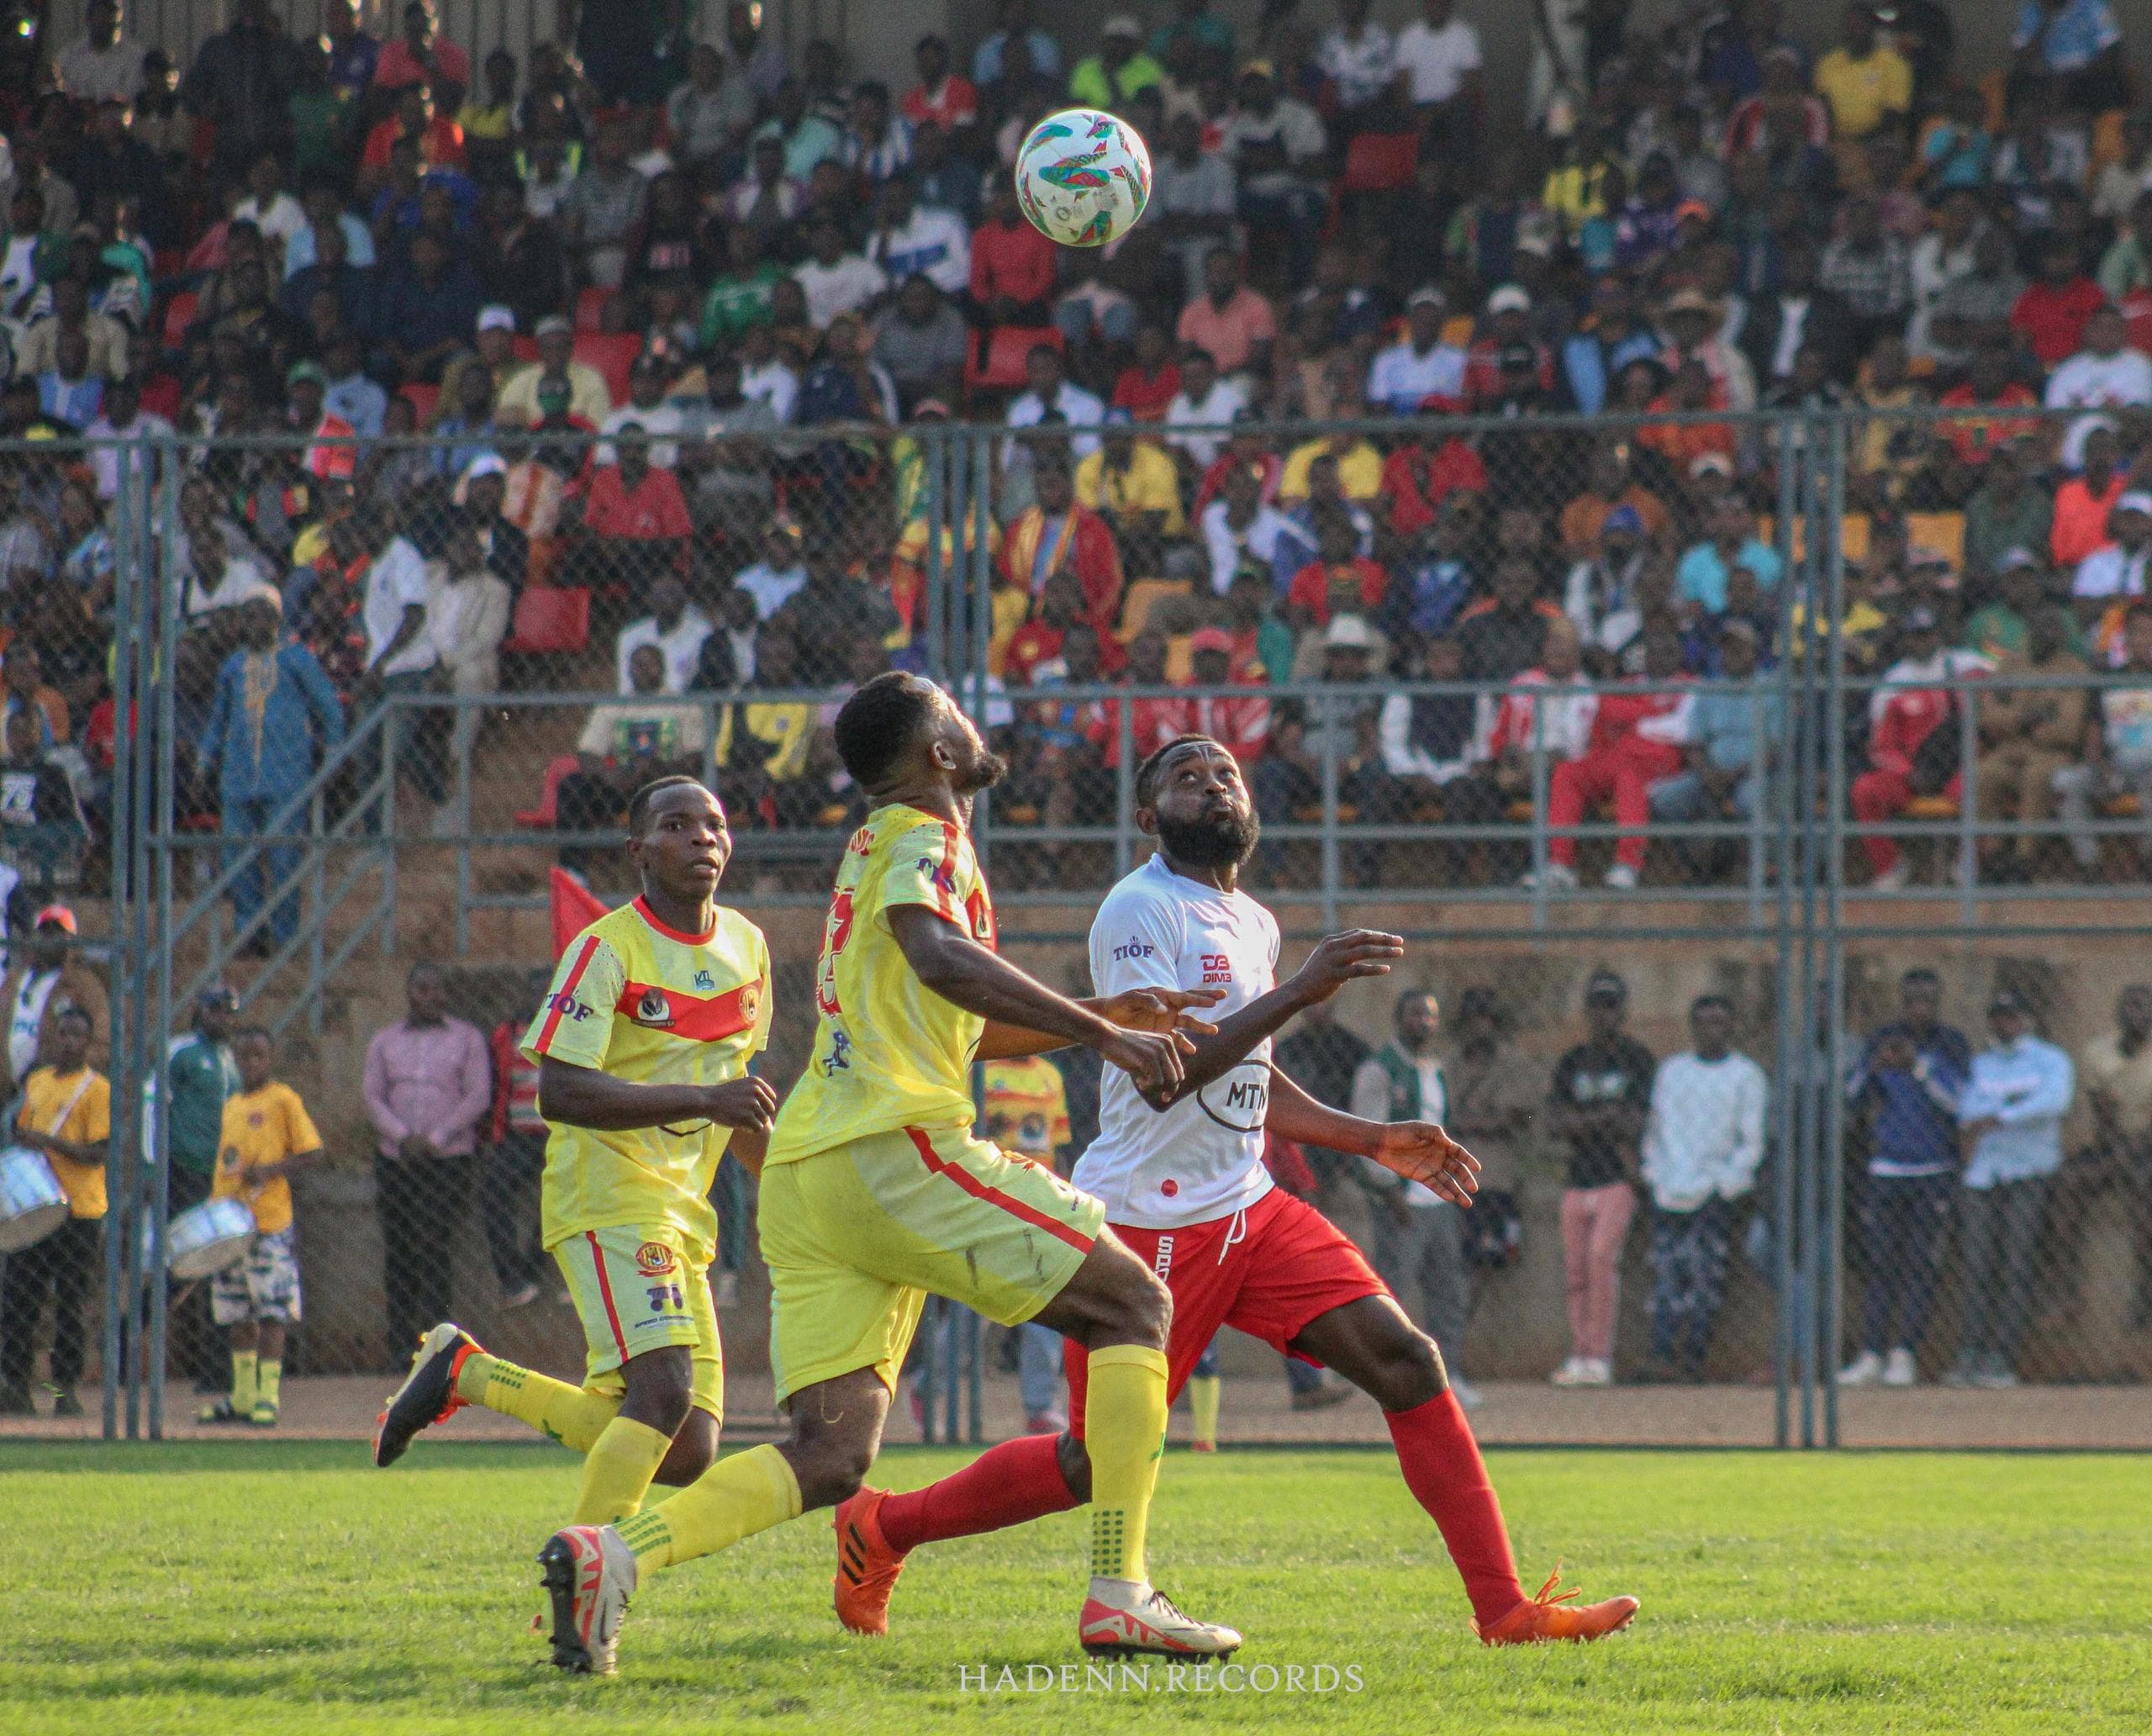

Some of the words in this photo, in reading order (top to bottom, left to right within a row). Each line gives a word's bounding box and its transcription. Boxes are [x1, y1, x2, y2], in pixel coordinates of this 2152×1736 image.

[1113, 944, 1154, 961] TIOF
[547, 993, 593, 1021] IOF
[1226, 1081, 1269, 1110] MTN
